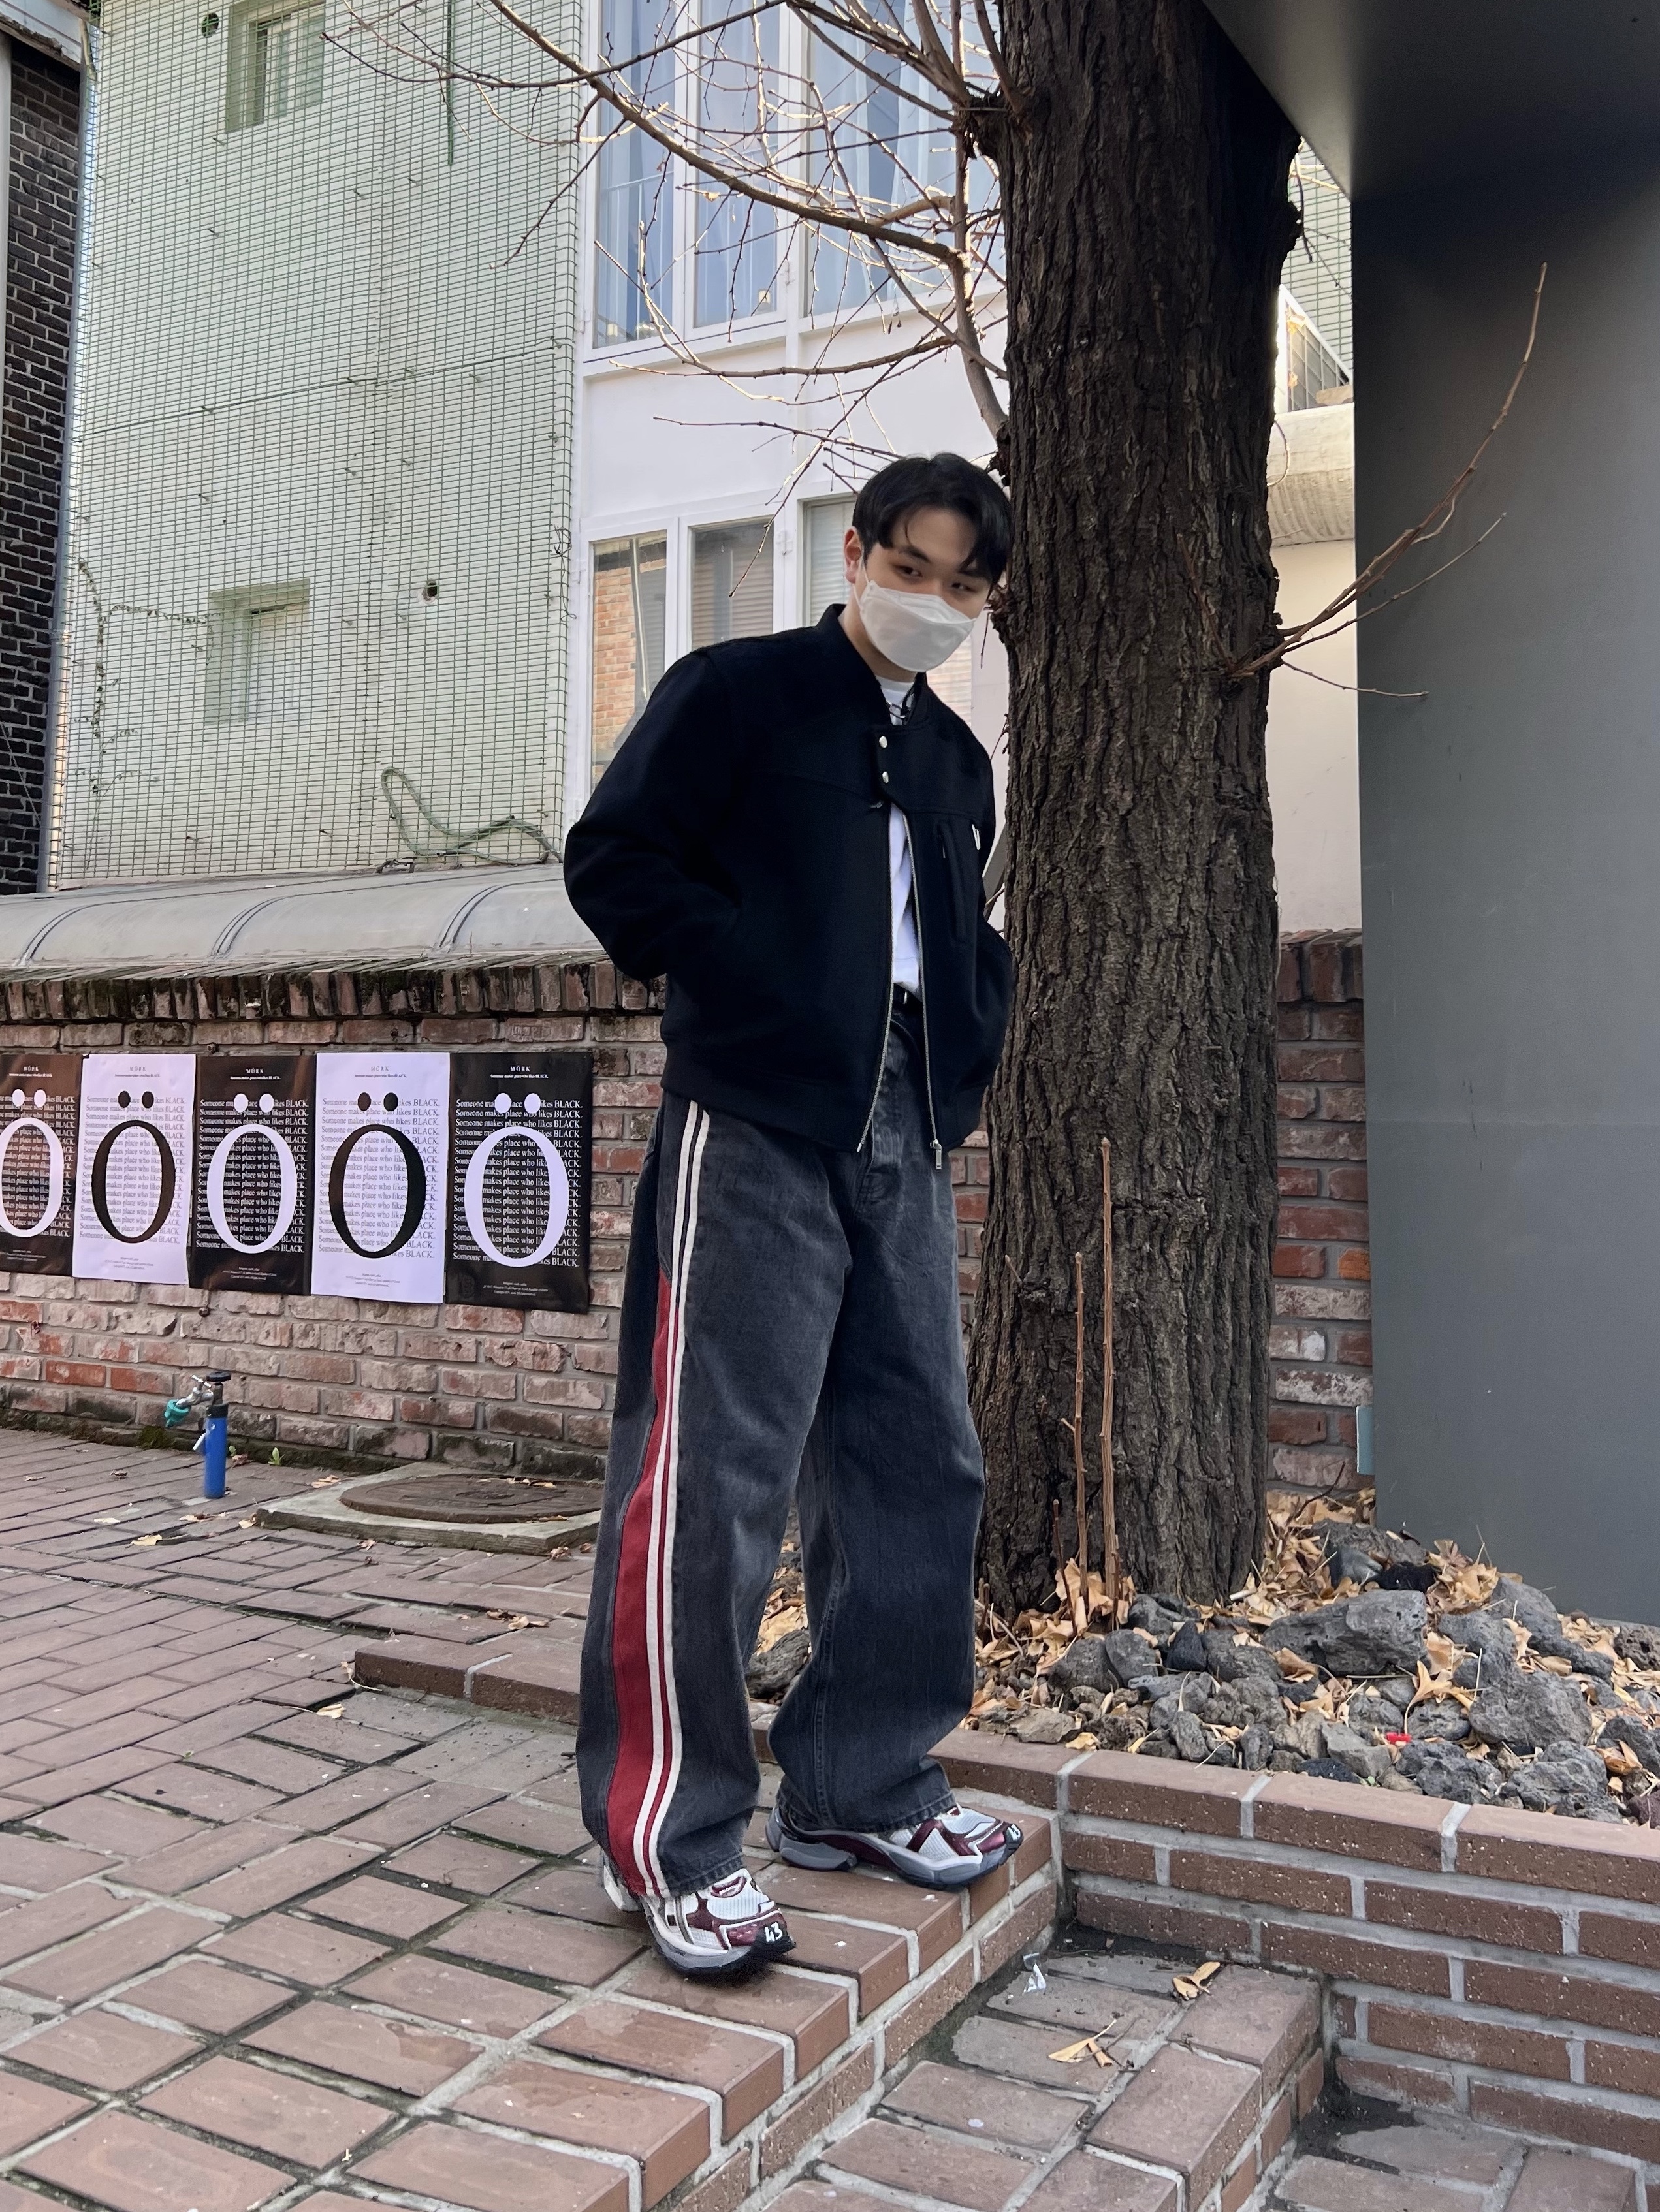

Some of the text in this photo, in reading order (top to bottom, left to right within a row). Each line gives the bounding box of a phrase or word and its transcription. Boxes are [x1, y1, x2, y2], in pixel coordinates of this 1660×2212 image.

[505, 1110, 522, 1119] place
[455, 1128, 482, 1136] Someone
[504, 1139, 520, 1148] place
[503, 1148, 520, 1158] place
[503, 1158, 520, 1167] place
[503, 1168, 519, 1177] place
[503, 1178, 519, 1187] place
[503, 1188, 519, 1197] place
[503, 1197, 519, 1207] place
[503, 1207, 519, 1216] place
[503, 1216, 519, 1226] place
[503, 1226, 519, 1236] place
[503, 1236, 519, 1246] place
[503, 1246, 519, 1256] place
[453, 1253, 481, 1261] Someone
[764, 1921, 783, 1942] 43
